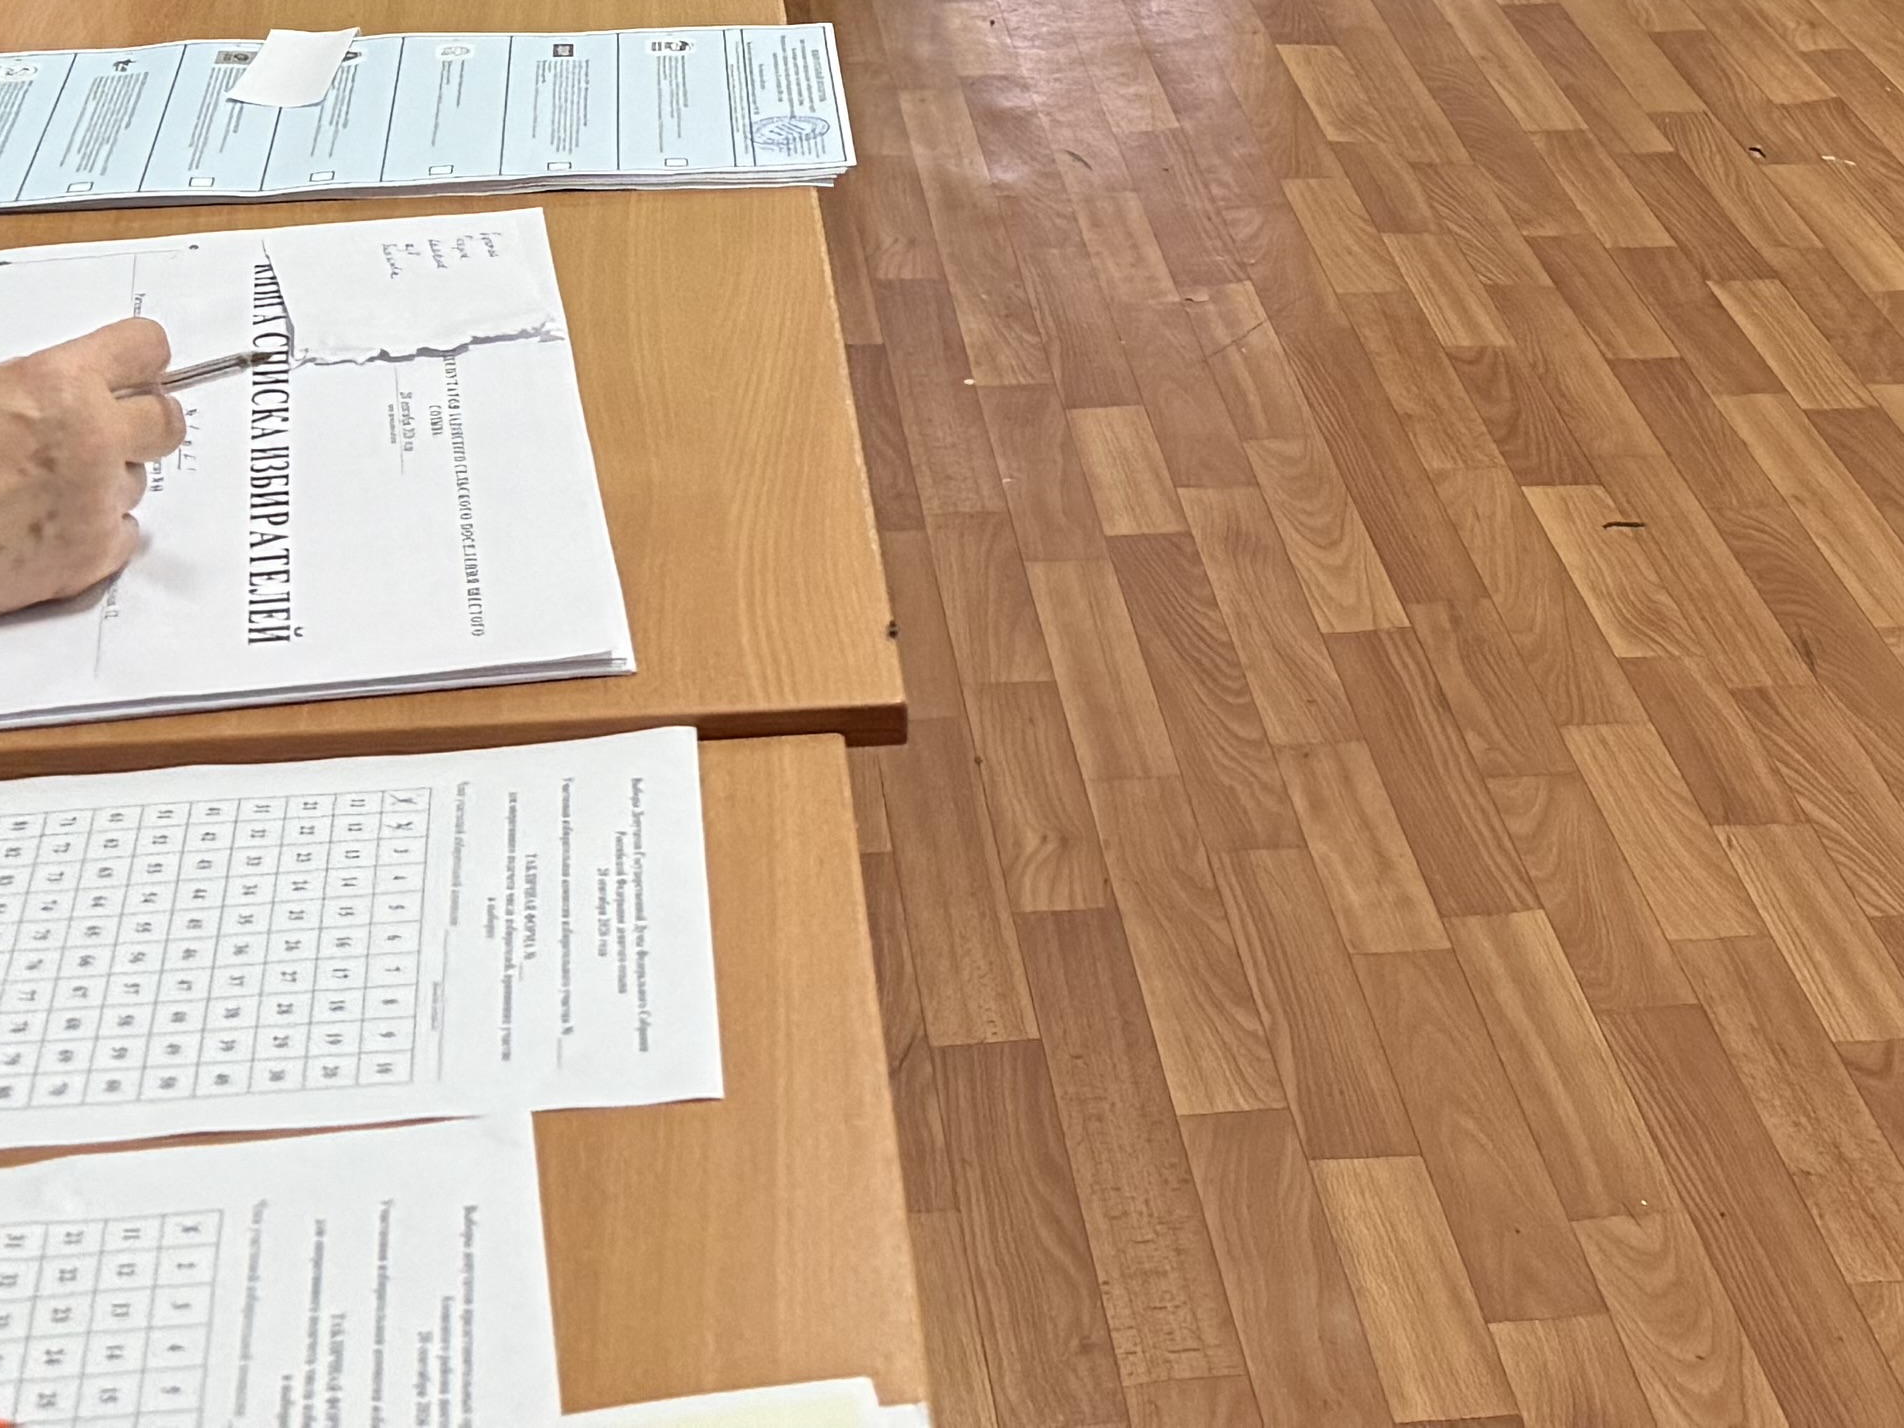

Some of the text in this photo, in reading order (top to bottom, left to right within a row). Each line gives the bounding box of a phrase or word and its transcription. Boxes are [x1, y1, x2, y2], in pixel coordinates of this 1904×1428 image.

[251, 331, 290, 441] СПИСКА
[247, 445, 303, 644] ИЗБИРАТЕЛЕЙ
[331, 798, 366, 980] 11 12 13 14 15 16 17
[386, 934, 403, 942] 6
[383, 965, 403, 973] 7
